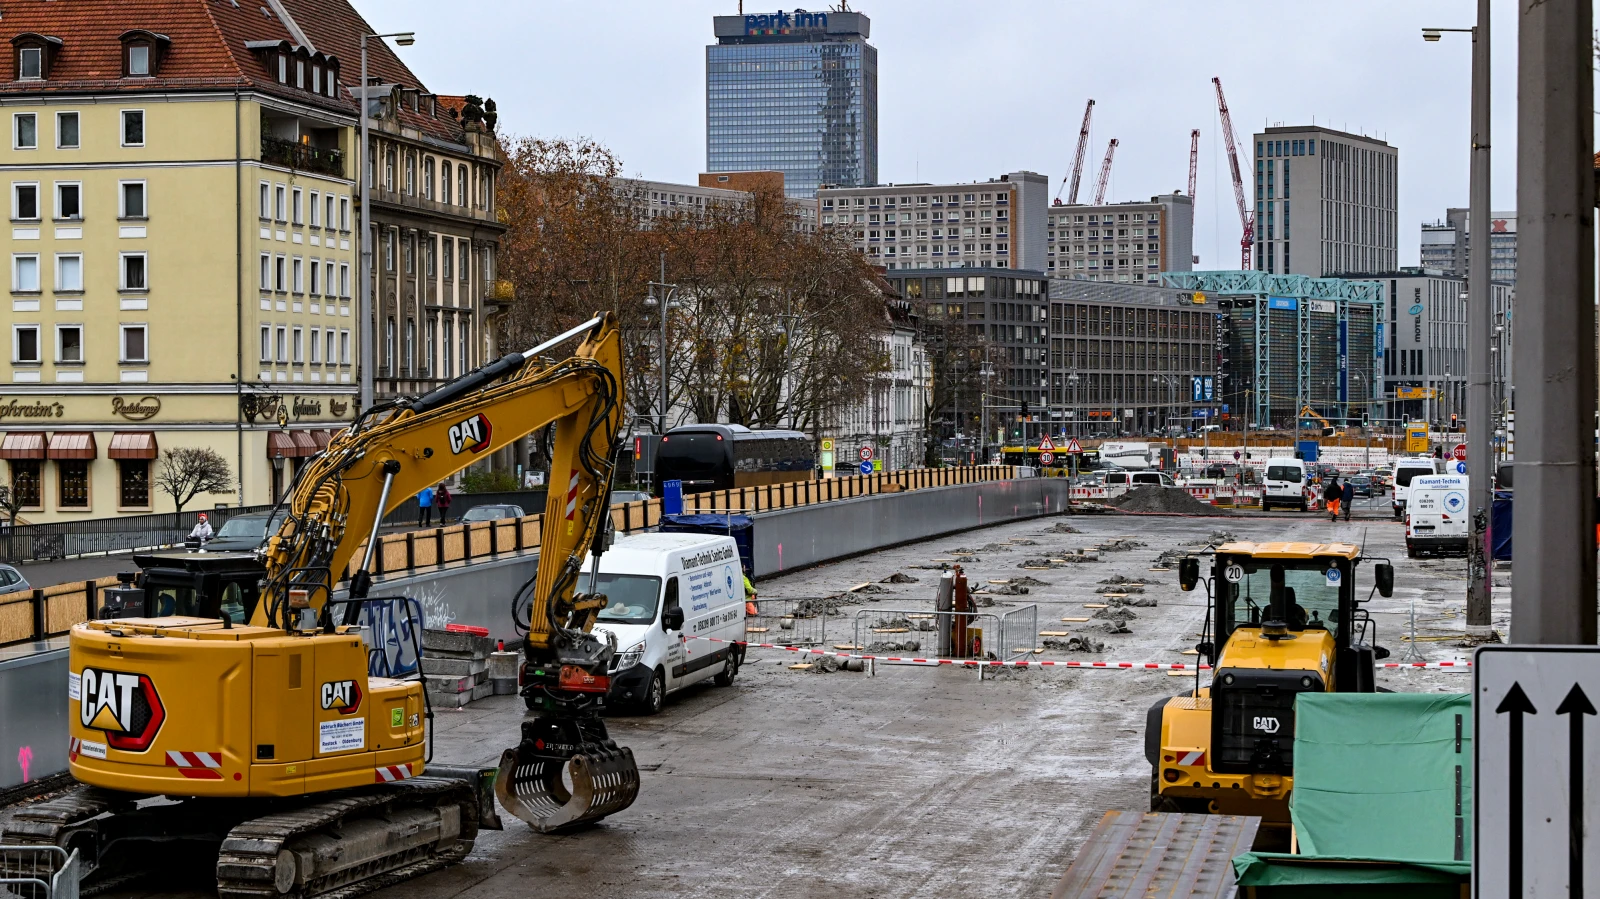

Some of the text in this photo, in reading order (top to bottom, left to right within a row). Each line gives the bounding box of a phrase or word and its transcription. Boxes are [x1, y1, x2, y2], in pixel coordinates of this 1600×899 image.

[745, 10, 828, 36] park inn
[1195, 384, 1201, 400] P
[1204, 378, 1213, 388] 600
[0, 397, 65, 419] phraim's
[112, 397, 160, 418] Radeberger
[448, 414, 482, 454] CAT
[1042, 454, 1051, 462] 30
[1228, 567, 1241, 579] 20
[81, 667, 139, 732] CAT
[321, 680, 353, 709] CAT
[1253, 716, 1274, 730] CAT
[341, 737, 362, 745] Oldenburg
